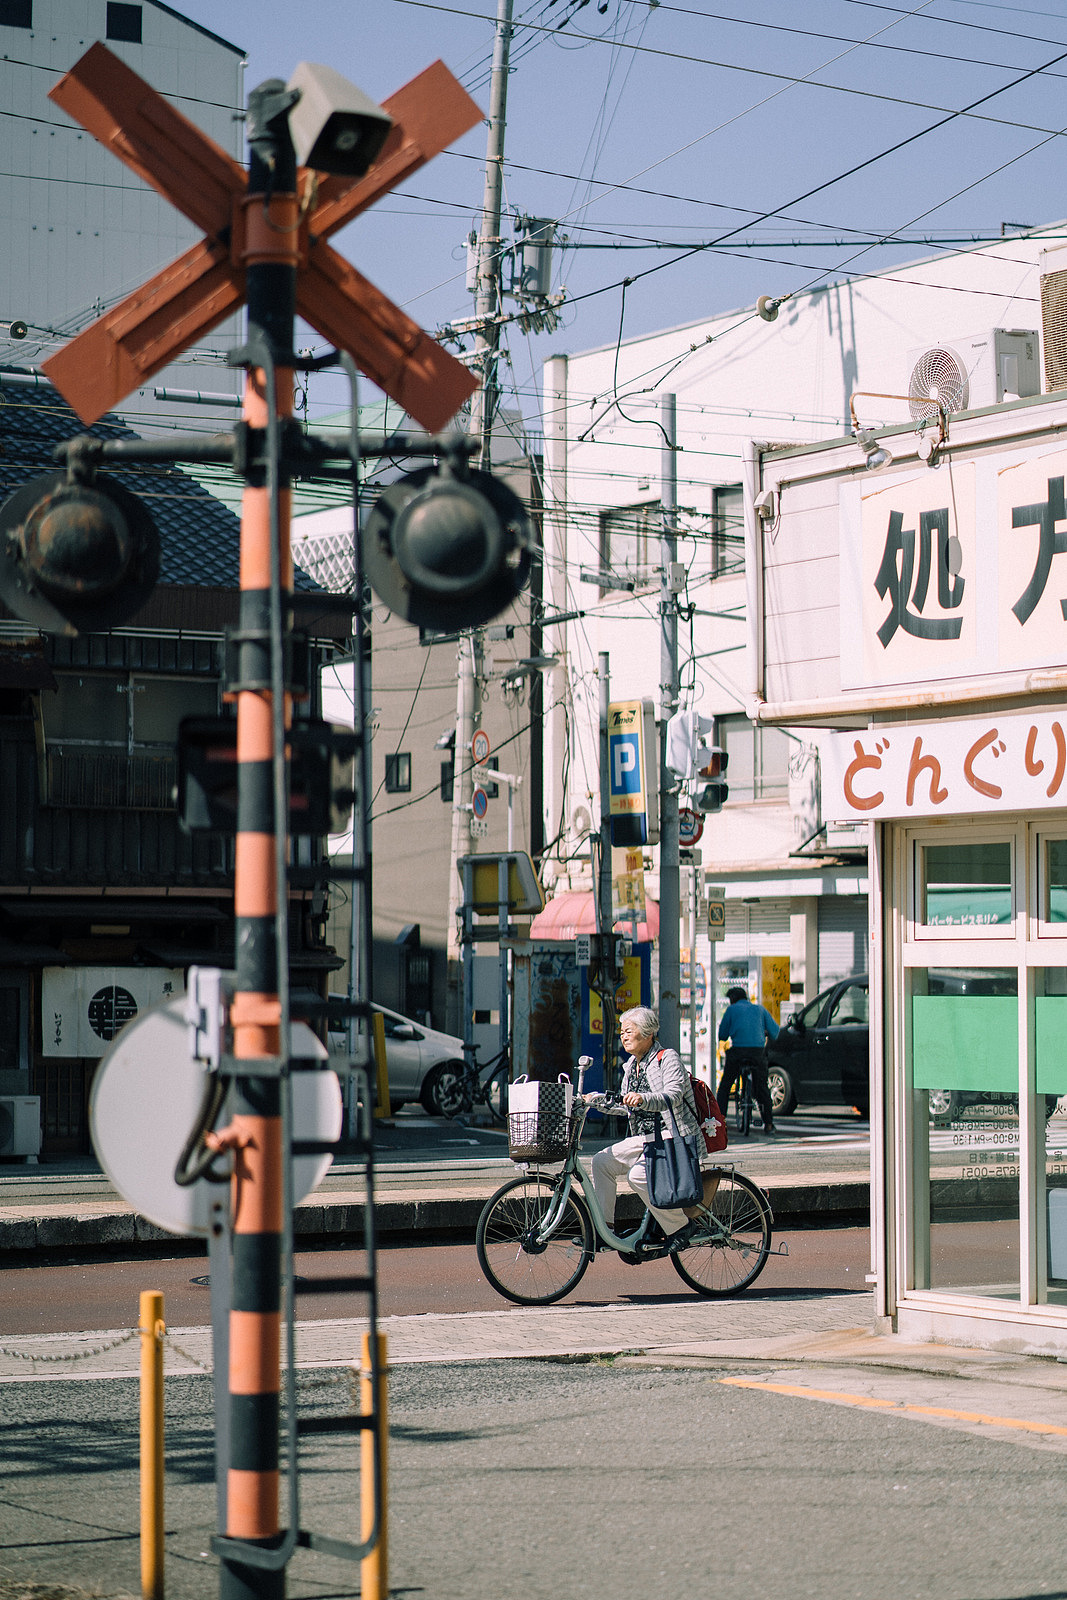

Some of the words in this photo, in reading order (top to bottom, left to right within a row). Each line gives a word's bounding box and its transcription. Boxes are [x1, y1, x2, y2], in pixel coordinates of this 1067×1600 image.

[613, 709, 637, 727] Times
[475, 739, 487, 757] 20
[614, 742, 636, 786] P
[843, 721, 1067, 811] どんぐり
